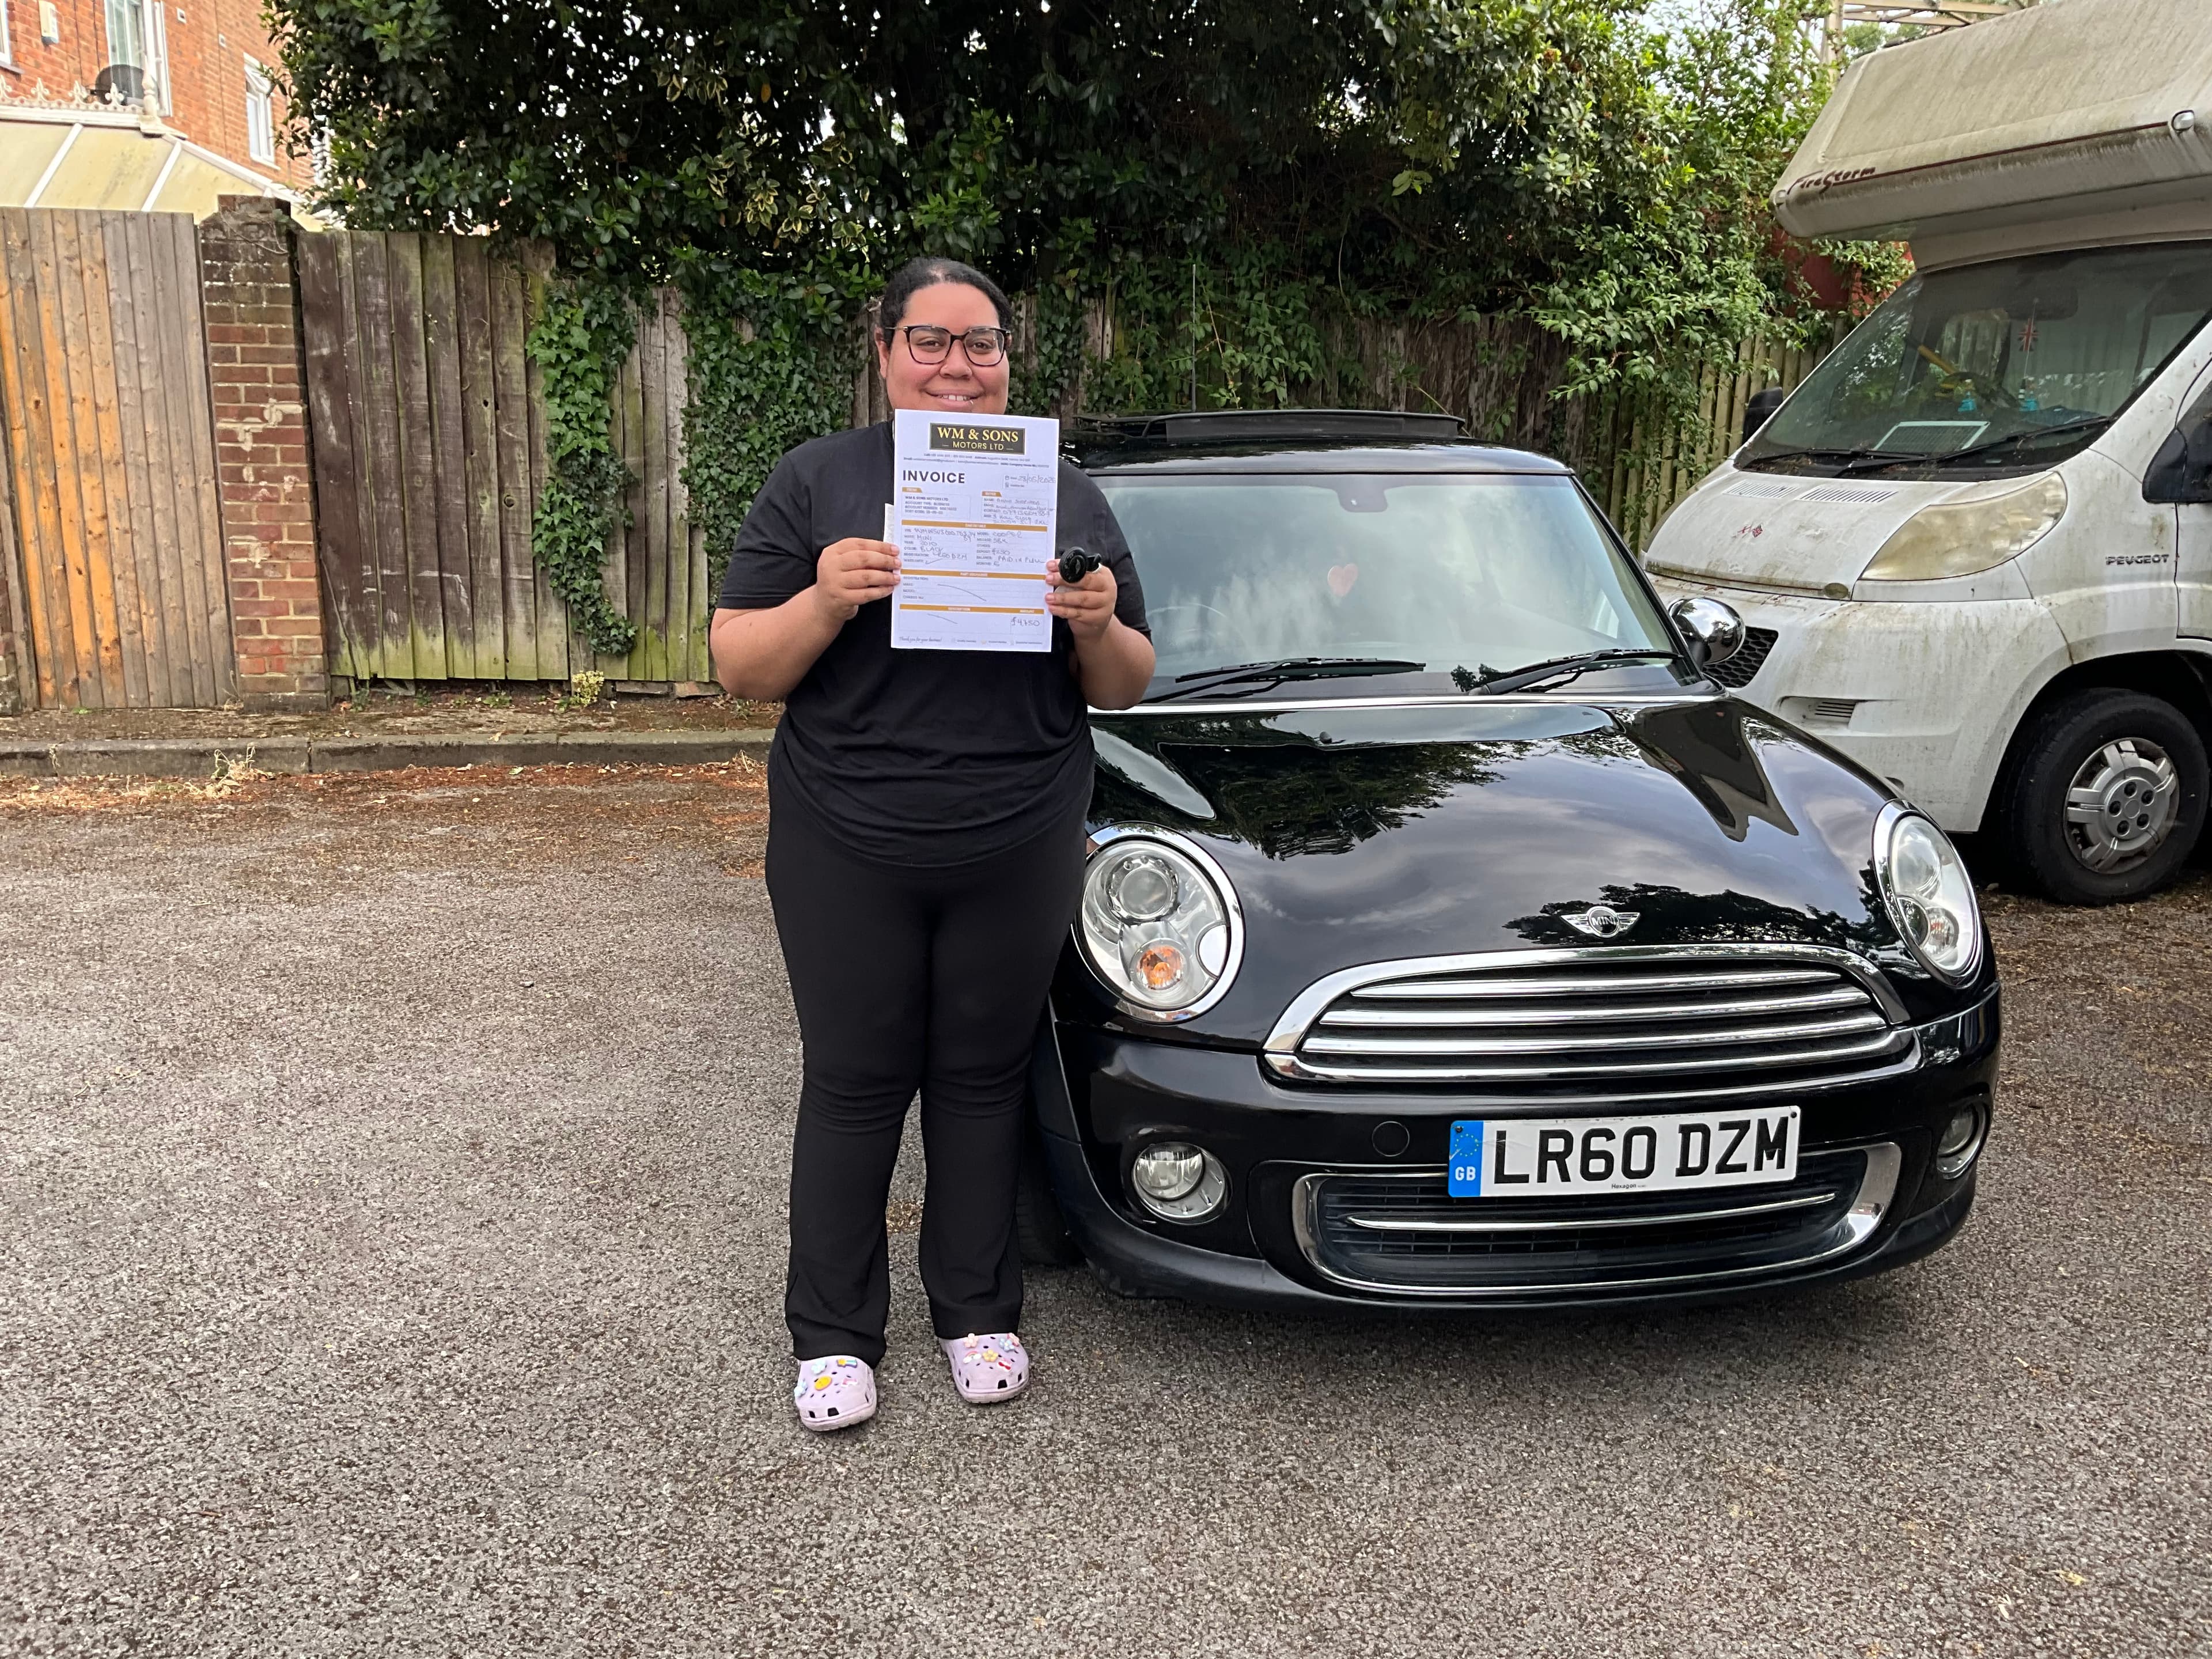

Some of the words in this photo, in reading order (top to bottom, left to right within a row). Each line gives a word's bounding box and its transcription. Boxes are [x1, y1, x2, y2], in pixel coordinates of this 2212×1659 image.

[938, 426, 964, 440] WM
[968, 429, 979, 441] &
[982, 430, 1019, 442] SONS
[953, 441, 987, 450] MOTORS
[990, 443, 1004, 451] LTD
[903, 469, 965, 484] INVOICE
[2106, 554, 2170, 565] PEUGEOT
[1591, 915, 1616, 926] MINI
[1494, 1126, 1657, 1185] LR60
[1675, 1116, 1789, 1177] DZM
[1455, 1166, 1476, 1182] GB
